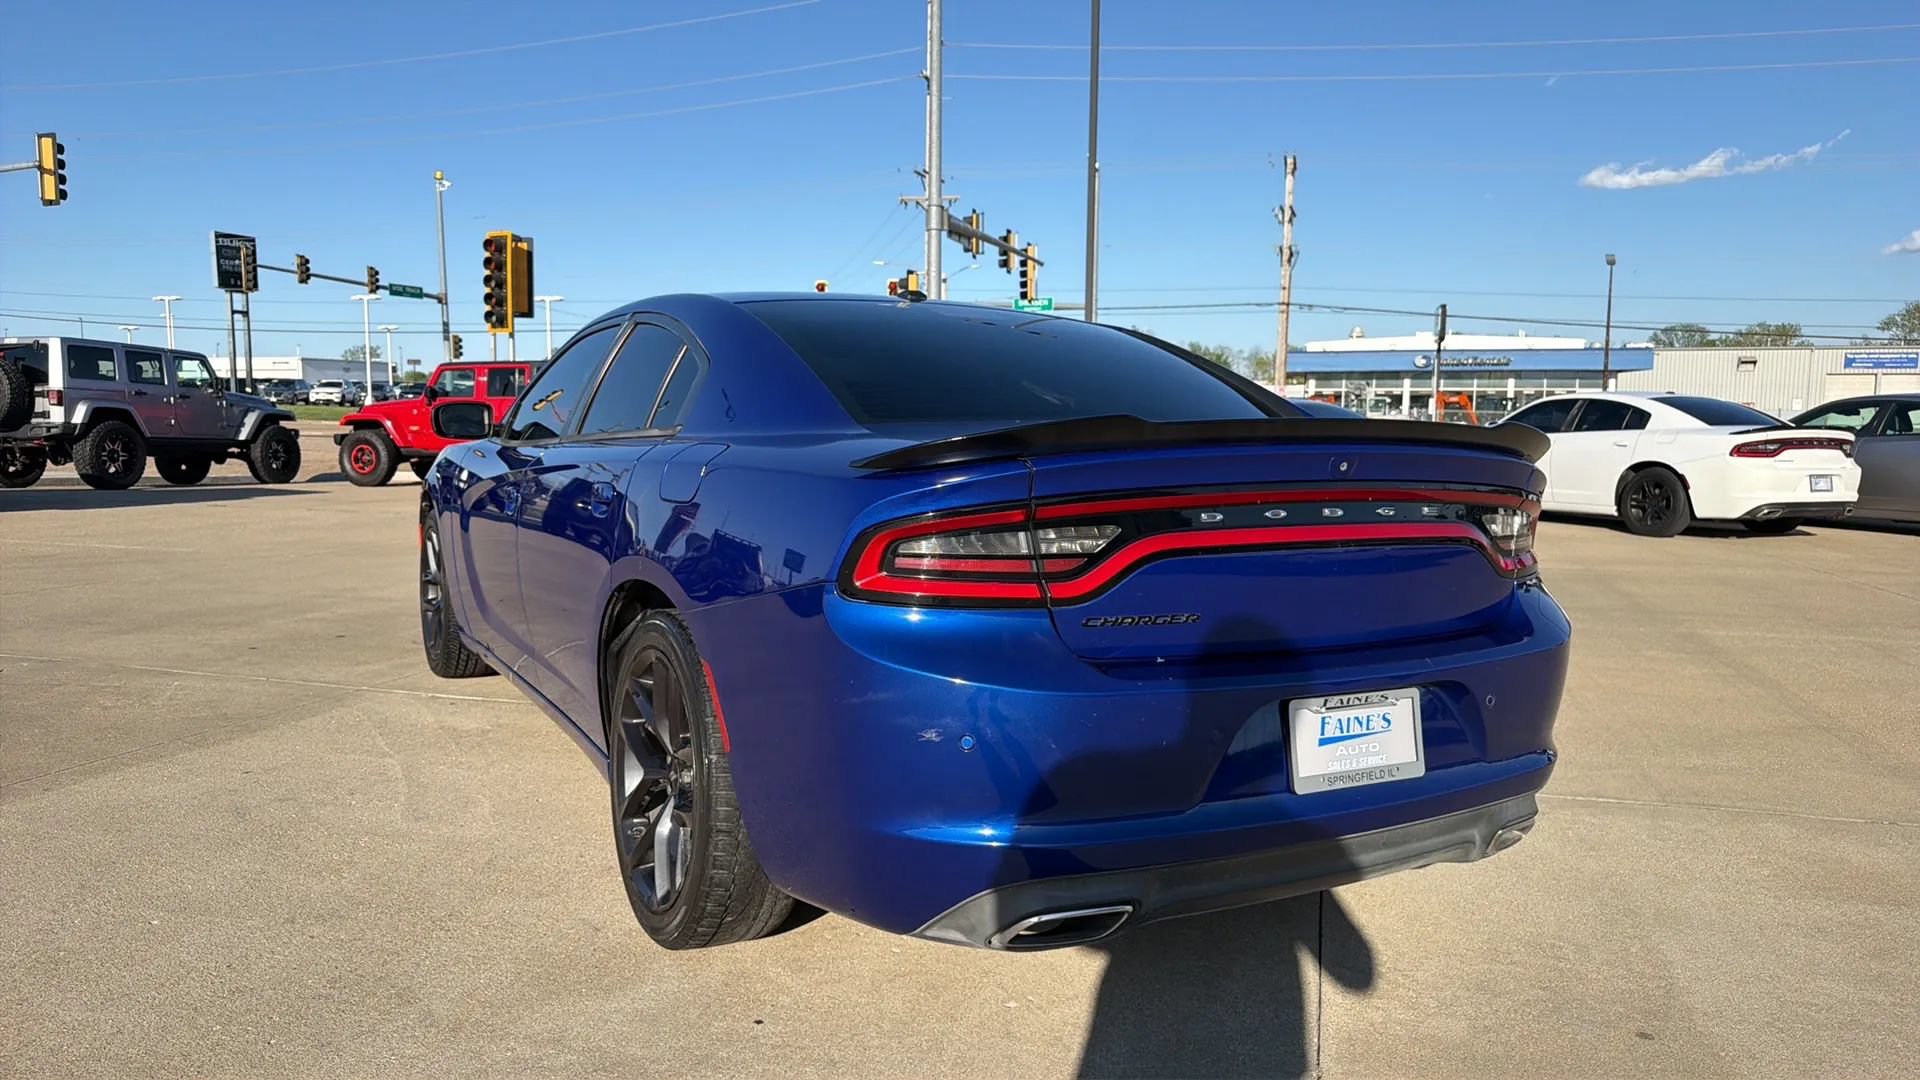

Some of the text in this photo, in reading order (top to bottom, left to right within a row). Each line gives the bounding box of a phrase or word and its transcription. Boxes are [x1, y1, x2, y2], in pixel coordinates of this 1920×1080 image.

[1200, 506, 1440, 522] DODGE
[1081, 612, 1201, 627] CHARGER
[1322, 693, 1389, 707] FAINE'S
[1320, 712, 1391, 736] FAINE'S
[1336, 743, 1380, 756] AUTO
[1328, 753, 1389, 771] SALES & SERVICE
[1327, 768, 1396, 787] SPRINGFIELD IL
